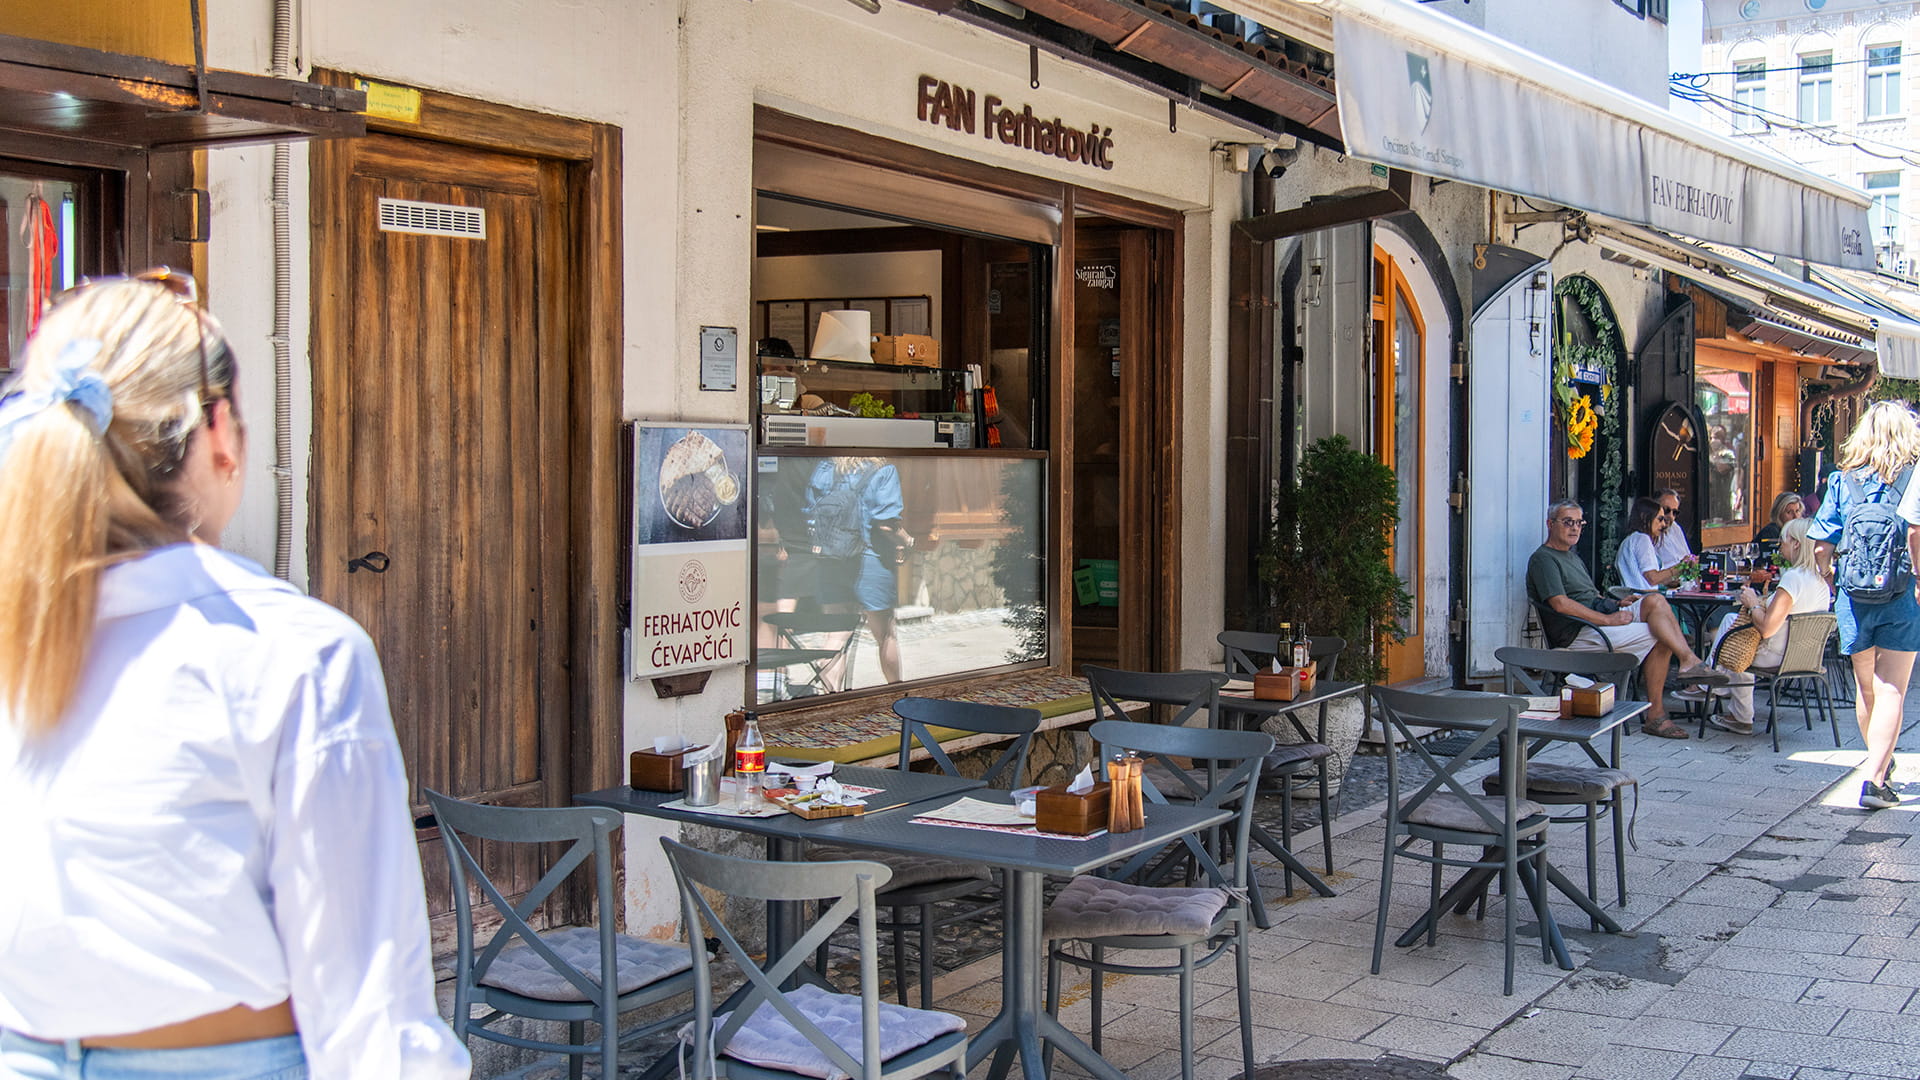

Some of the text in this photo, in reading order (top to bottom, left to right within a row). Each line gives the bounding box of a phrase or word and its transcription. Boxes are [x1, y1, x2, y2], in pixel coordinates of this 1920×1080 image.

[917, 74, 1114, 170] FAN Ferhatović
[1652, 175, 1734, 225] FAN FERHATOVIĆ
[644, 601, 740, 637] FERHATOVIĆ
[651, 633, 733, 668] ĆEVAPČIĆI
